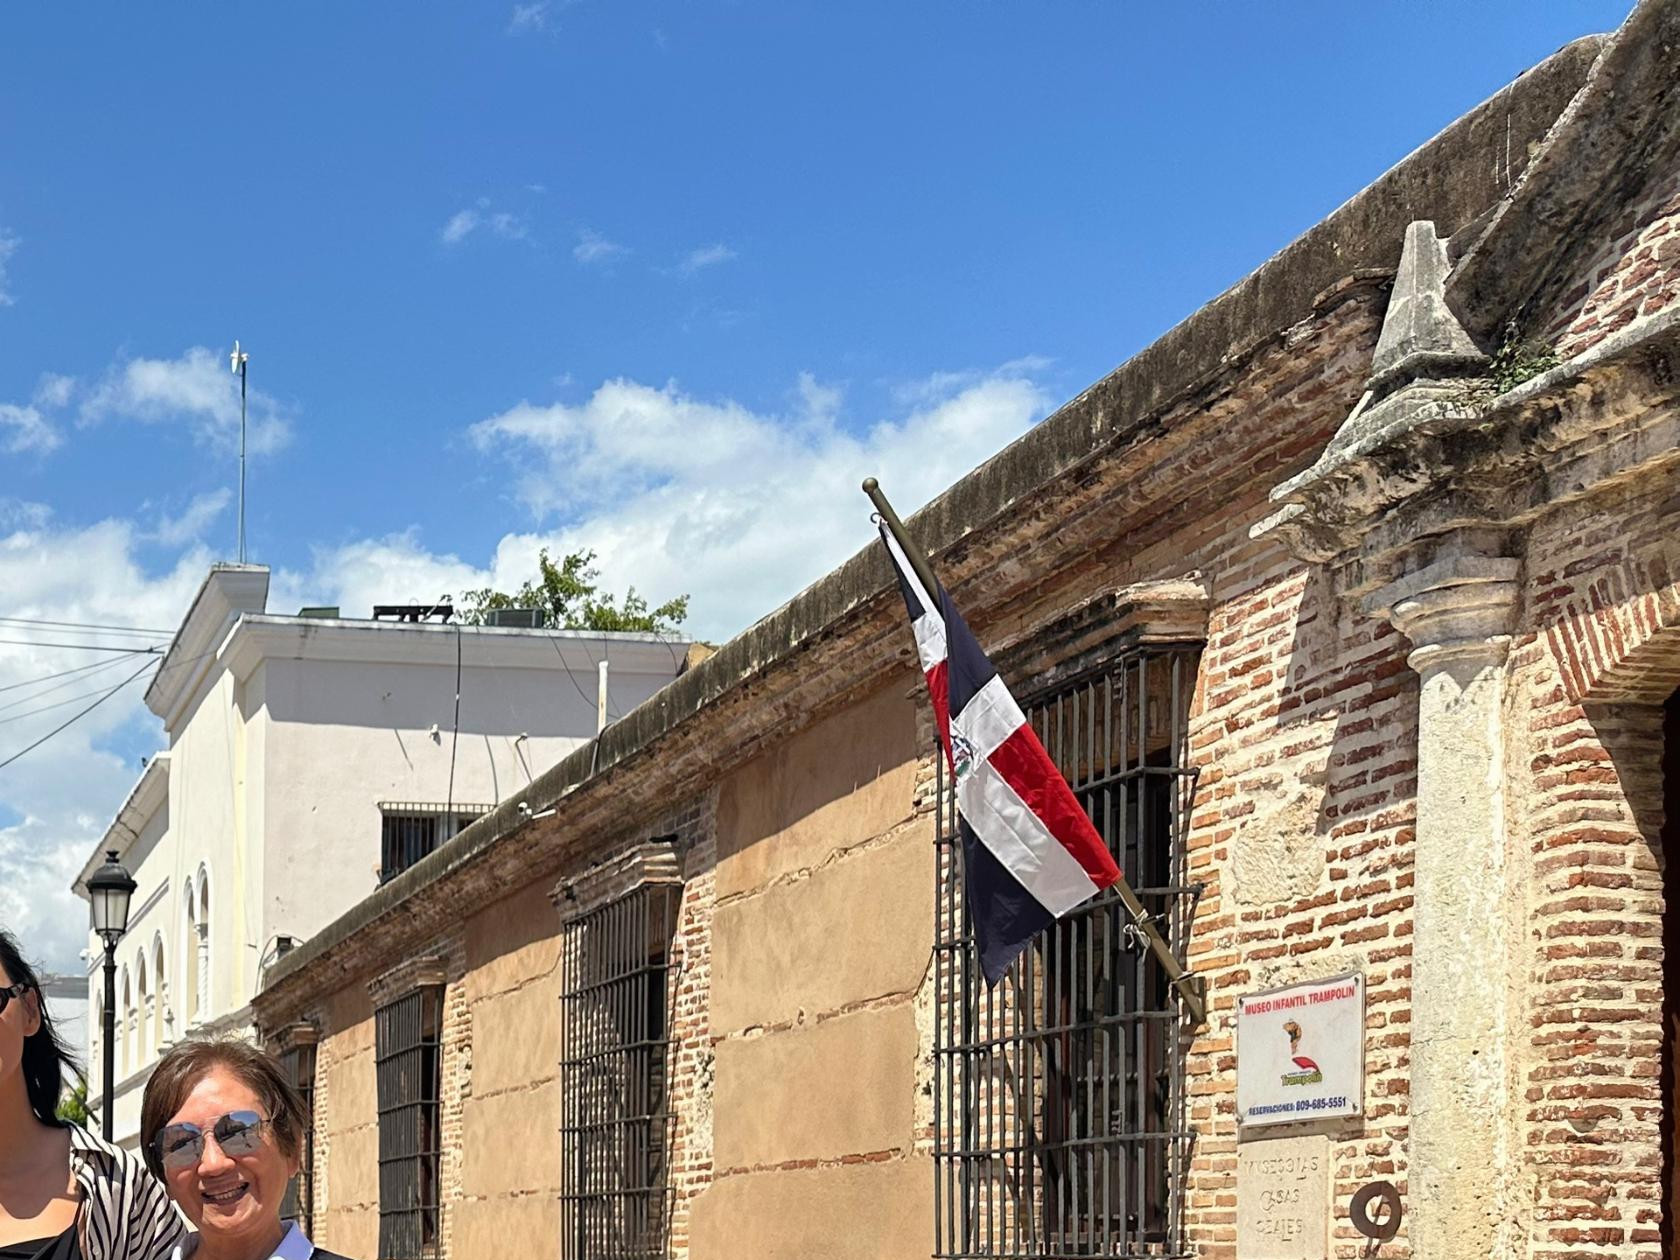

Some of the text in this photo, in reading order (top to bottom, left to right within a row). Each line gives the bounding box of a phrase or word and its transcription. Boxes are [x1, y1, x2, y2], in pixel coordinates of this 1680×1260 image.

[1245, 985, 1355, 1015] MUSEO INFANTIL TRAMPOLIN
[1249, 1096, 1347, 1116] RESERVACIONES: 809-685-5551
